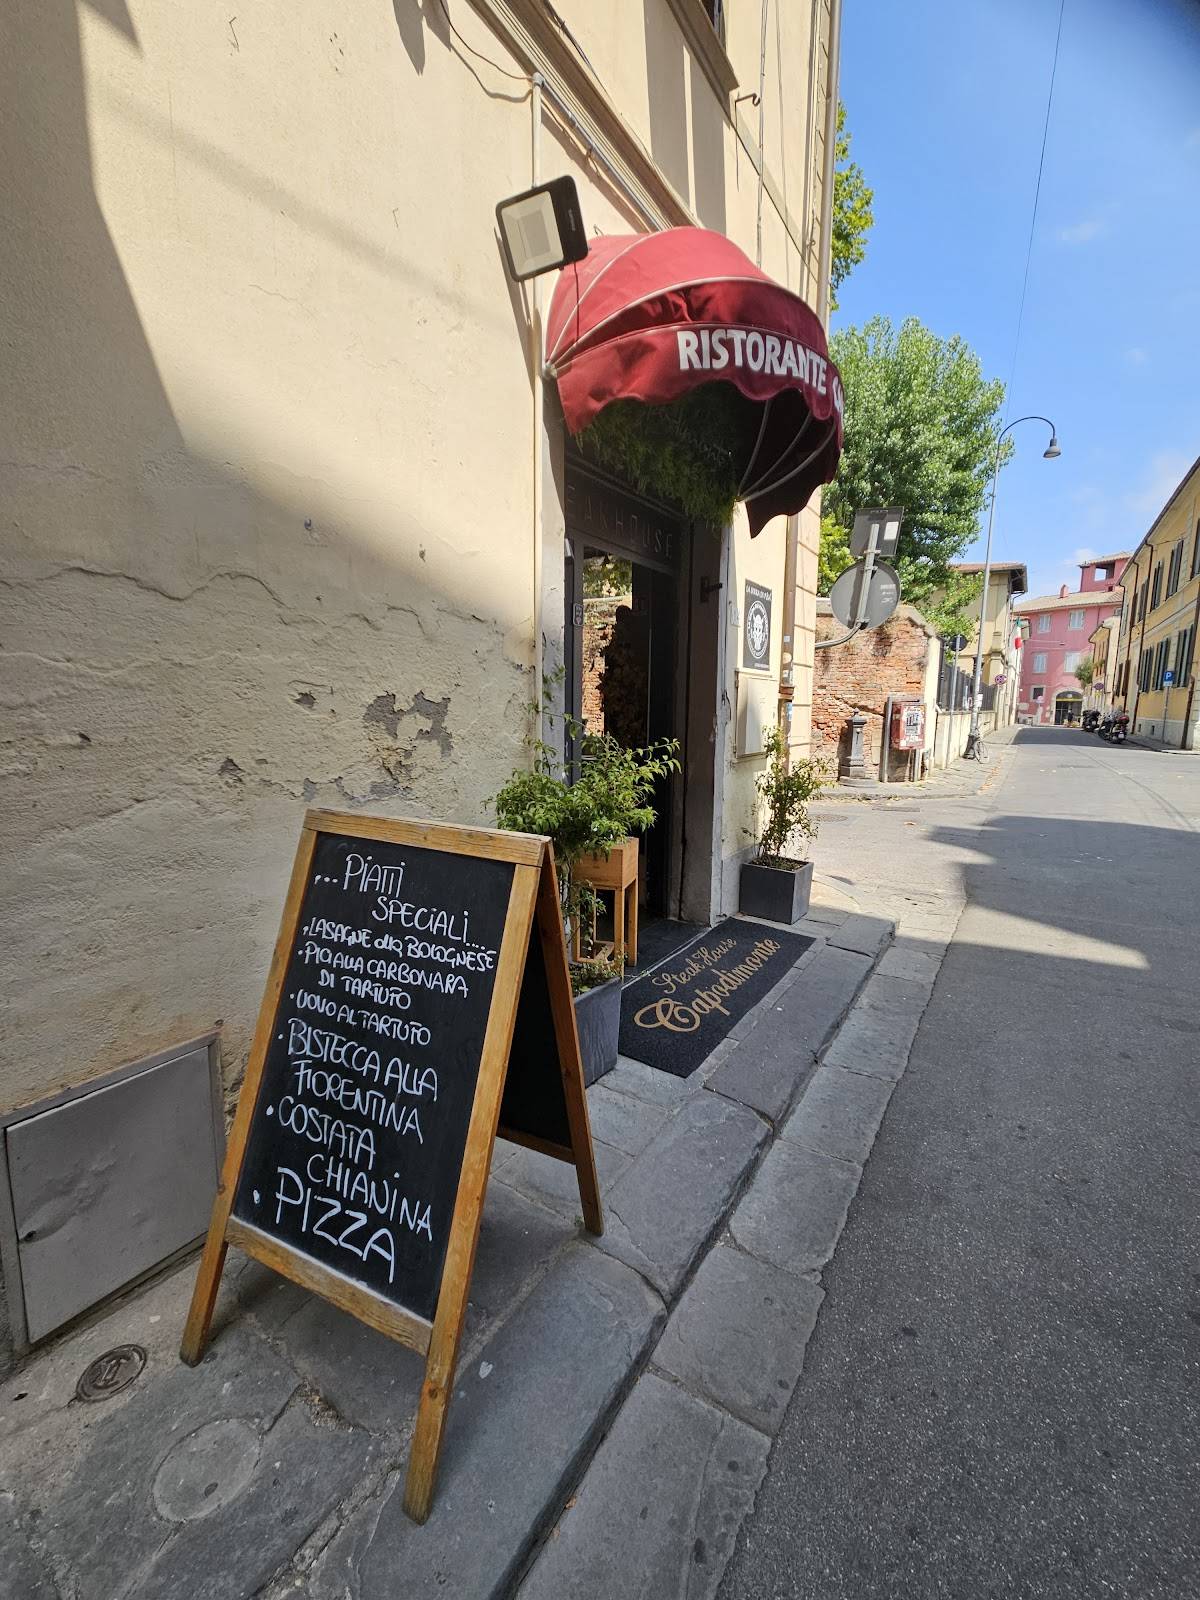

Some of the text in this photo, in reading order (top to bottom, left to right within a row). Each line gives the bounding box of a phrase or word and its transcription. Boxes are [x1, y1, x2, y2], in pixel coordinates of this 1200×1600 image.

[677, 328, 828, 396] RISTORANTE
[309, 917, 372, 948] LASAGNE
[404, 936, 497, 972] BOLOGNESE
[366, 959, 469, 998] CARBONARA
[652, 937, 737, 994] Steak House
[296, 989, 431, 1046] UOVO AL TARTUFO
[317, 968, 412, 1010] DI TARTUFO
[633, 937, 781, 1032] Capodimonte
[287, 1017, 438, 1102] BISTECCA ALLA
[278, 1095, 377, 1170] COSTATA
[292, 1059, 424, 1145] FIORENTINA
[275, 1166, 396, 1284] PIZZA
